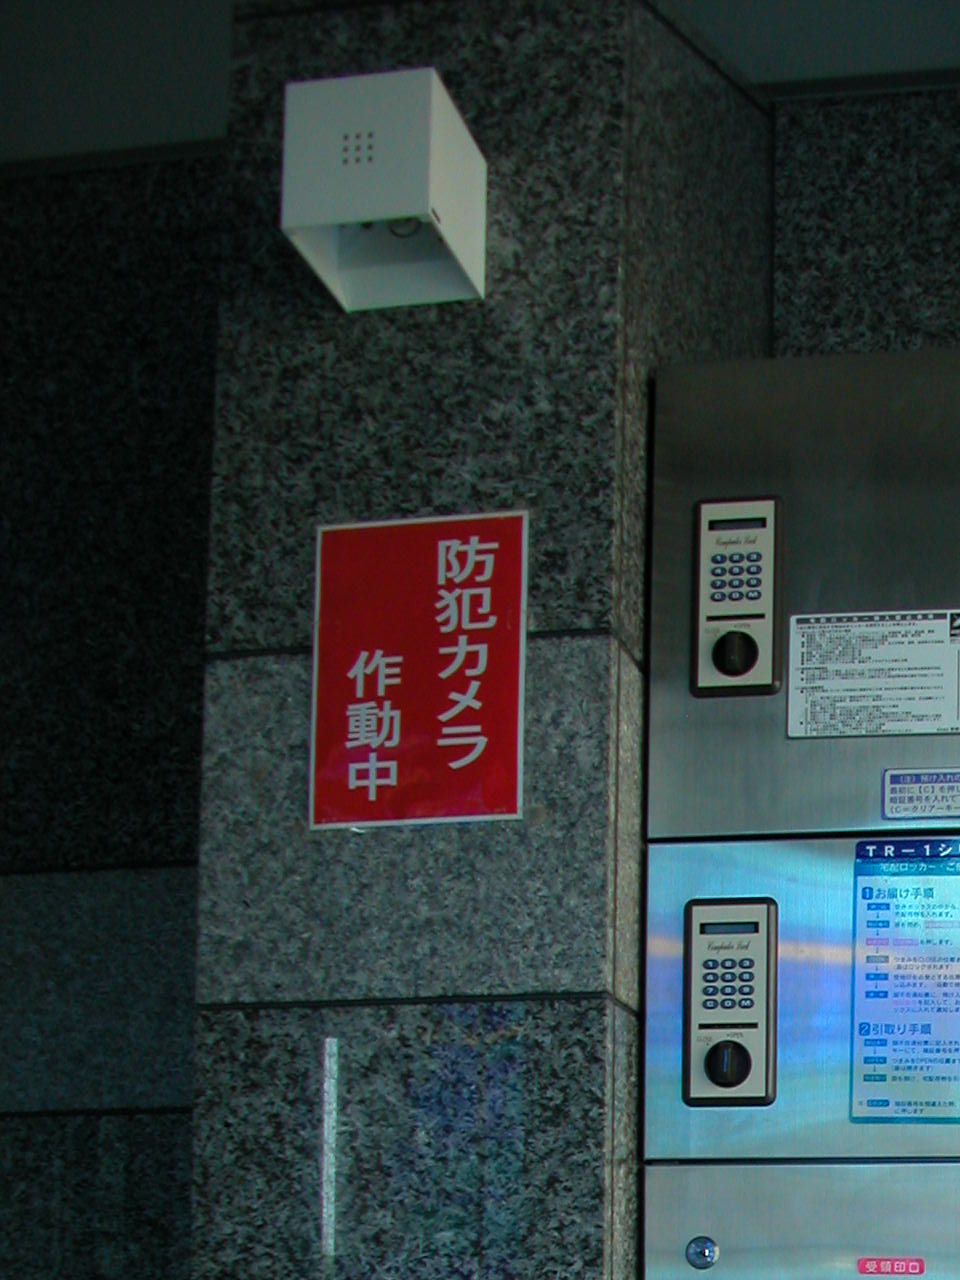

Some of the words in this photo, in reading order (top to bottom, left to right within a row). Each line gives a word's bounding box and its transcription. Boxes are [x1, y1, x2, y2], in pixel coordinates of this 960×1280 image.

[434, 535, 499, 770] 防犯カメラ
[345, 649, 403, 802] 作動中
[875, 887, 934, 901] お届け手順
[872, 1023, 932, 1036] 引取り手順
[865, 1260, 920, 1274] 受領印口
